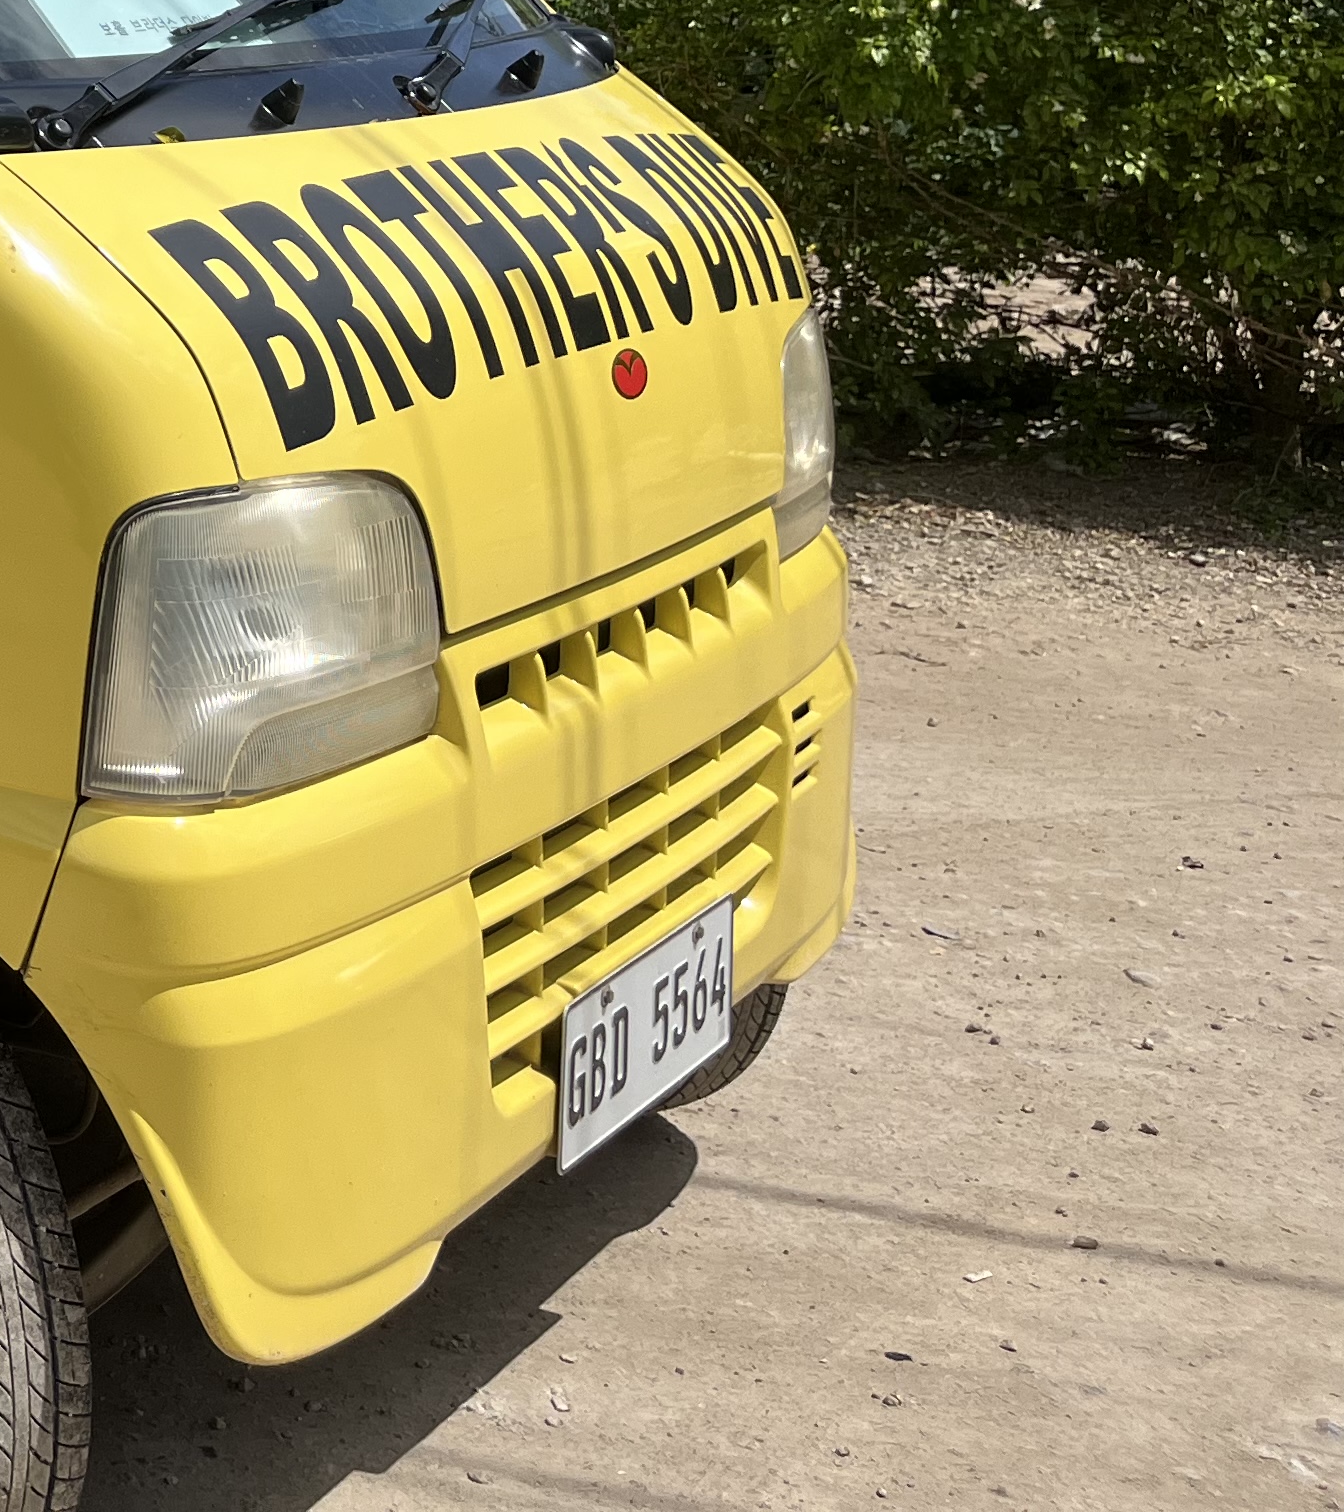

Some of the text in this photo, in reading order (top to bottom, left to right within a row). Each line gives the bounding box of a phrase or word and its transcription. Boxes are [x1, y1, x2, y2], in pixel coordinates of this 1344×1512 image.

[147, 132, 804, 453] BROTHER'S DIVE
[568, 933, 726, 1129] GBD 5564
